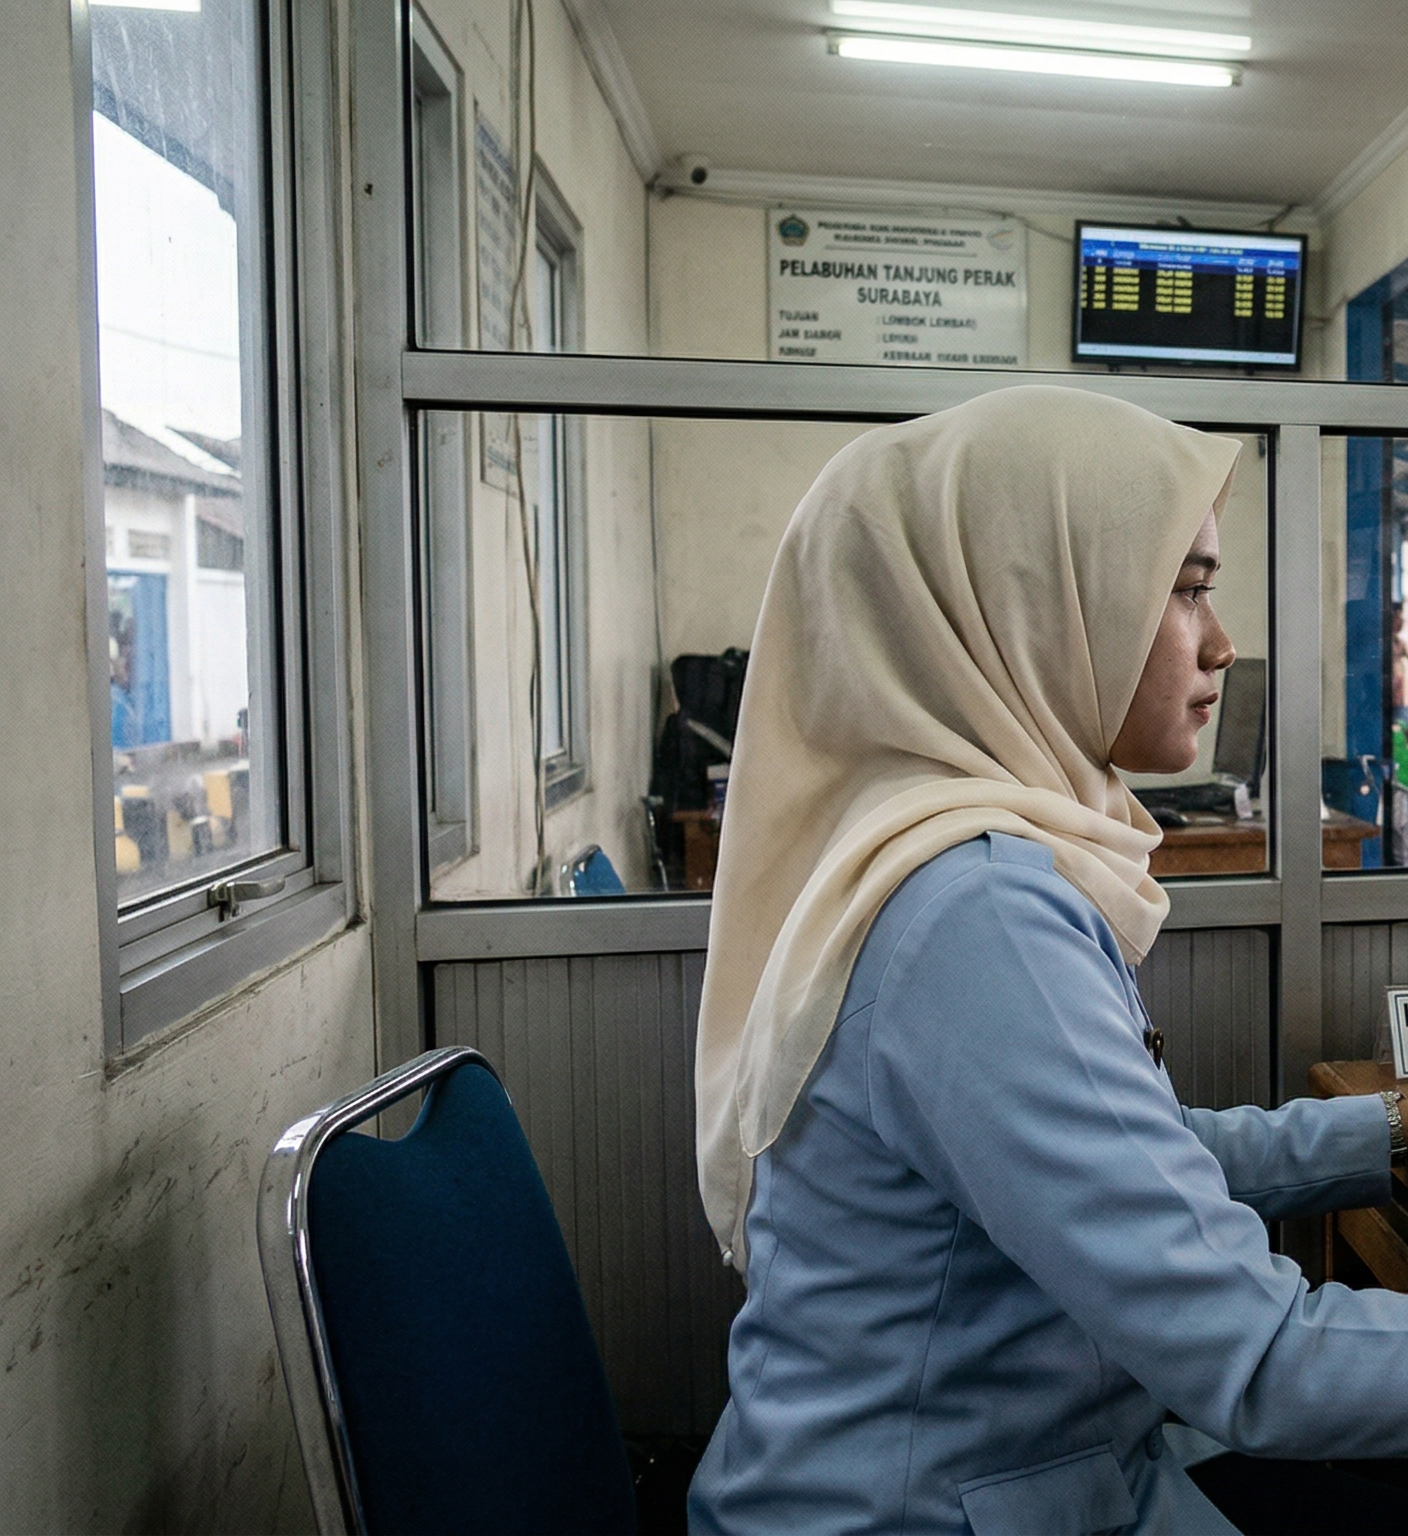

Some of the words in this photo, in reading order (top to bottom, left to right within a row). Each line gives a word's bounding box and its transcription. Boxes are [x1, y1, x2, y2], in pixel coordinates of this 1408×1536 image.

[779, 259, 878, 280] PELABUHAN
[883, 264, 958, 284] TANJUNG
[963, 269, 1016, 287] PERAK
[857, 287, 942, 307] SURABAYA
